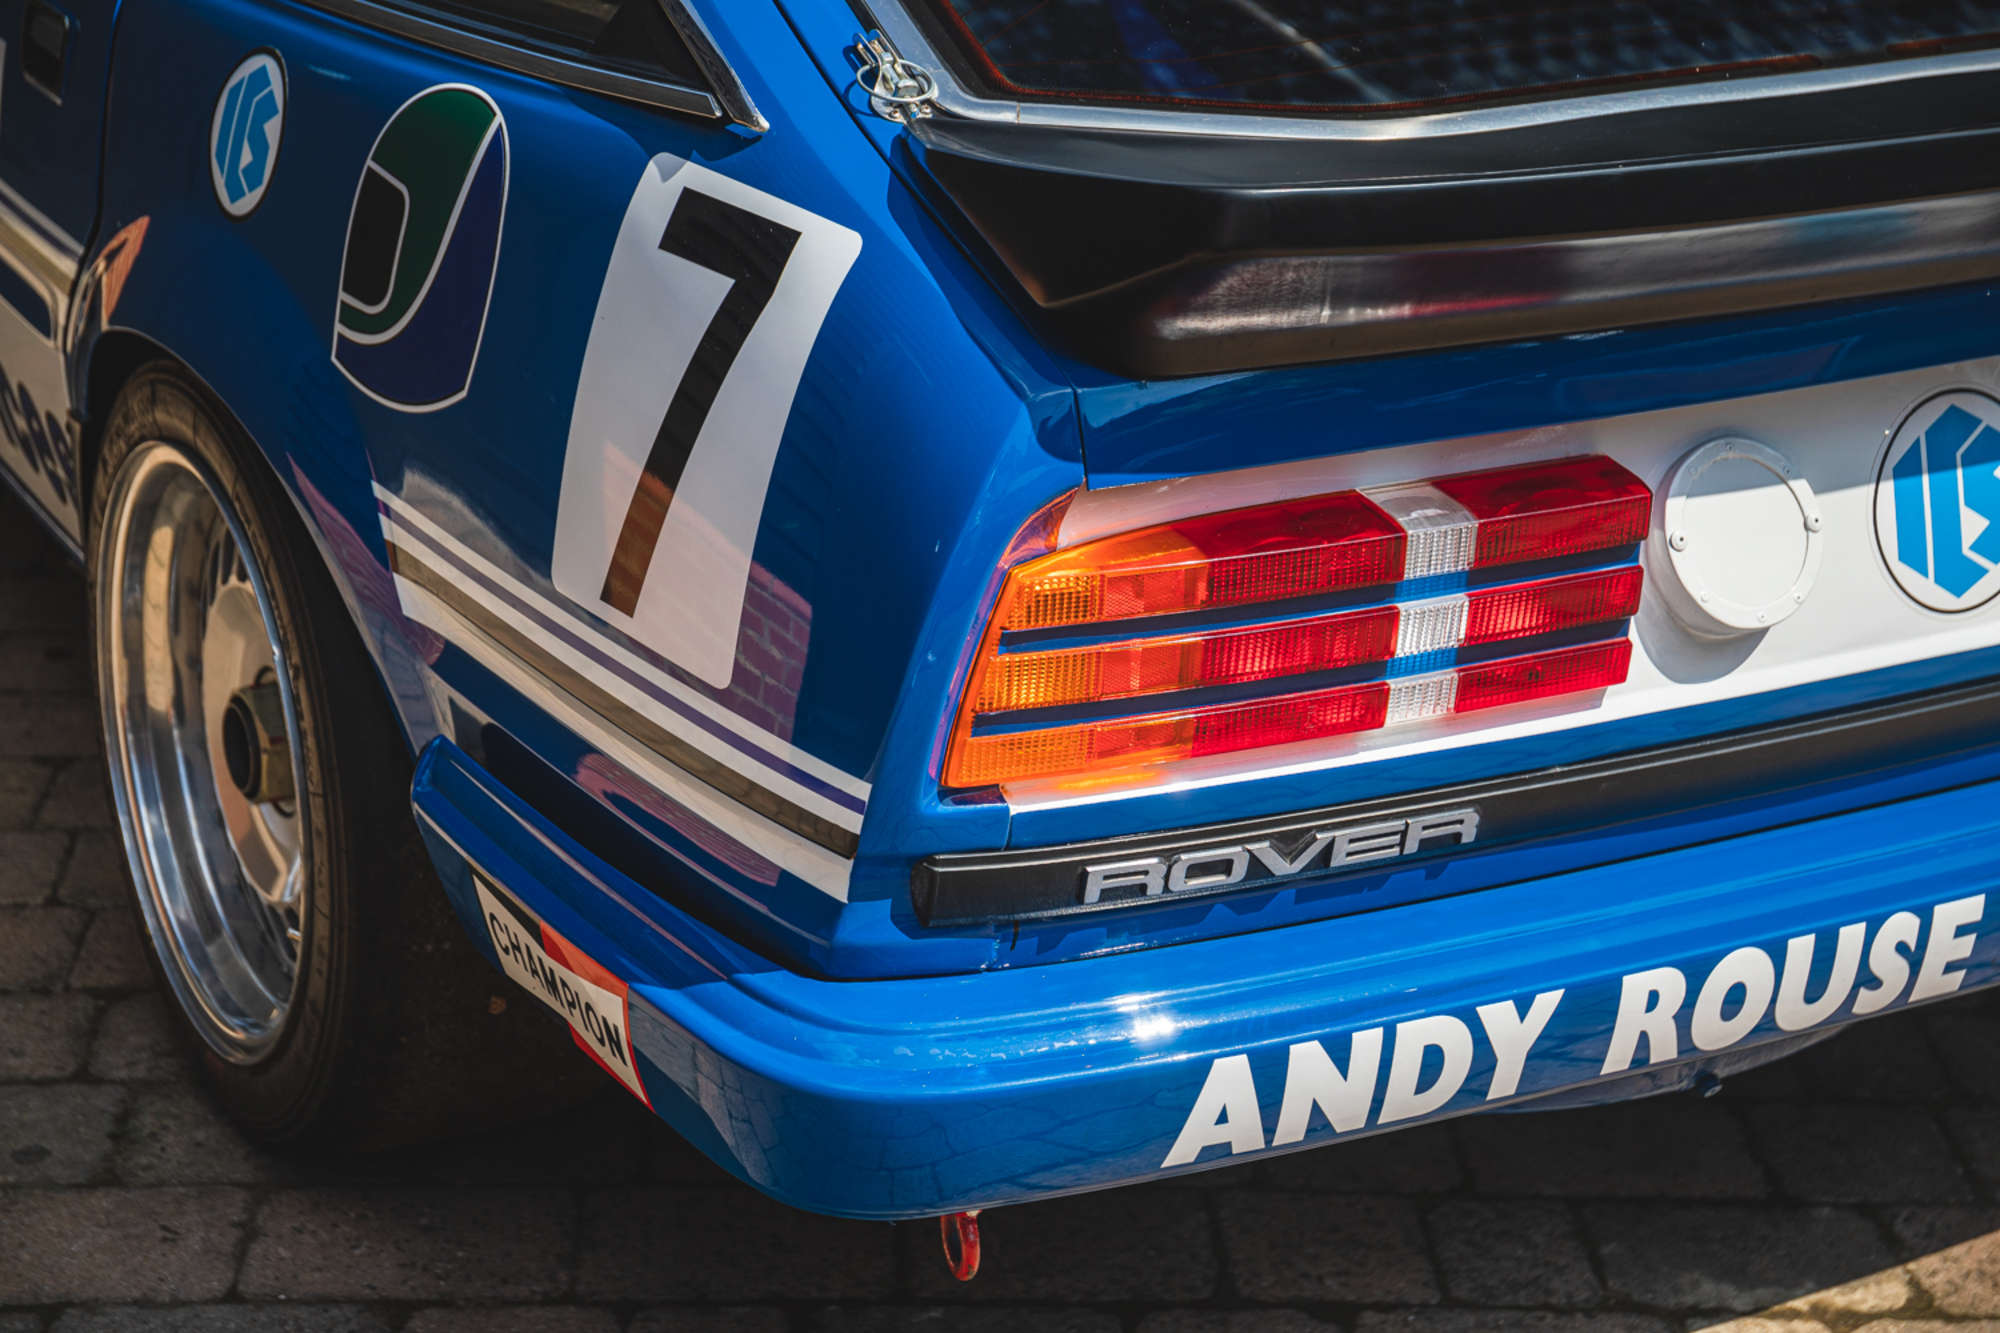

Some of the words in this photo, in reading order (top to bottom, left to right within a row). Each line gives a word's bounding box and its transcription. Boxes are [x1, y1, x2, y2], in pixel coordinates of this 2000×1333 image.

[600, 186, 802, 618] 7
[1084, 807, 1480, 904] ROVER
[489, 912, 628, 1067] CHAMPION
[1161, 988, 1565, 1168] ANDY
[1601, 893, 1985, 1075] ROUSE
